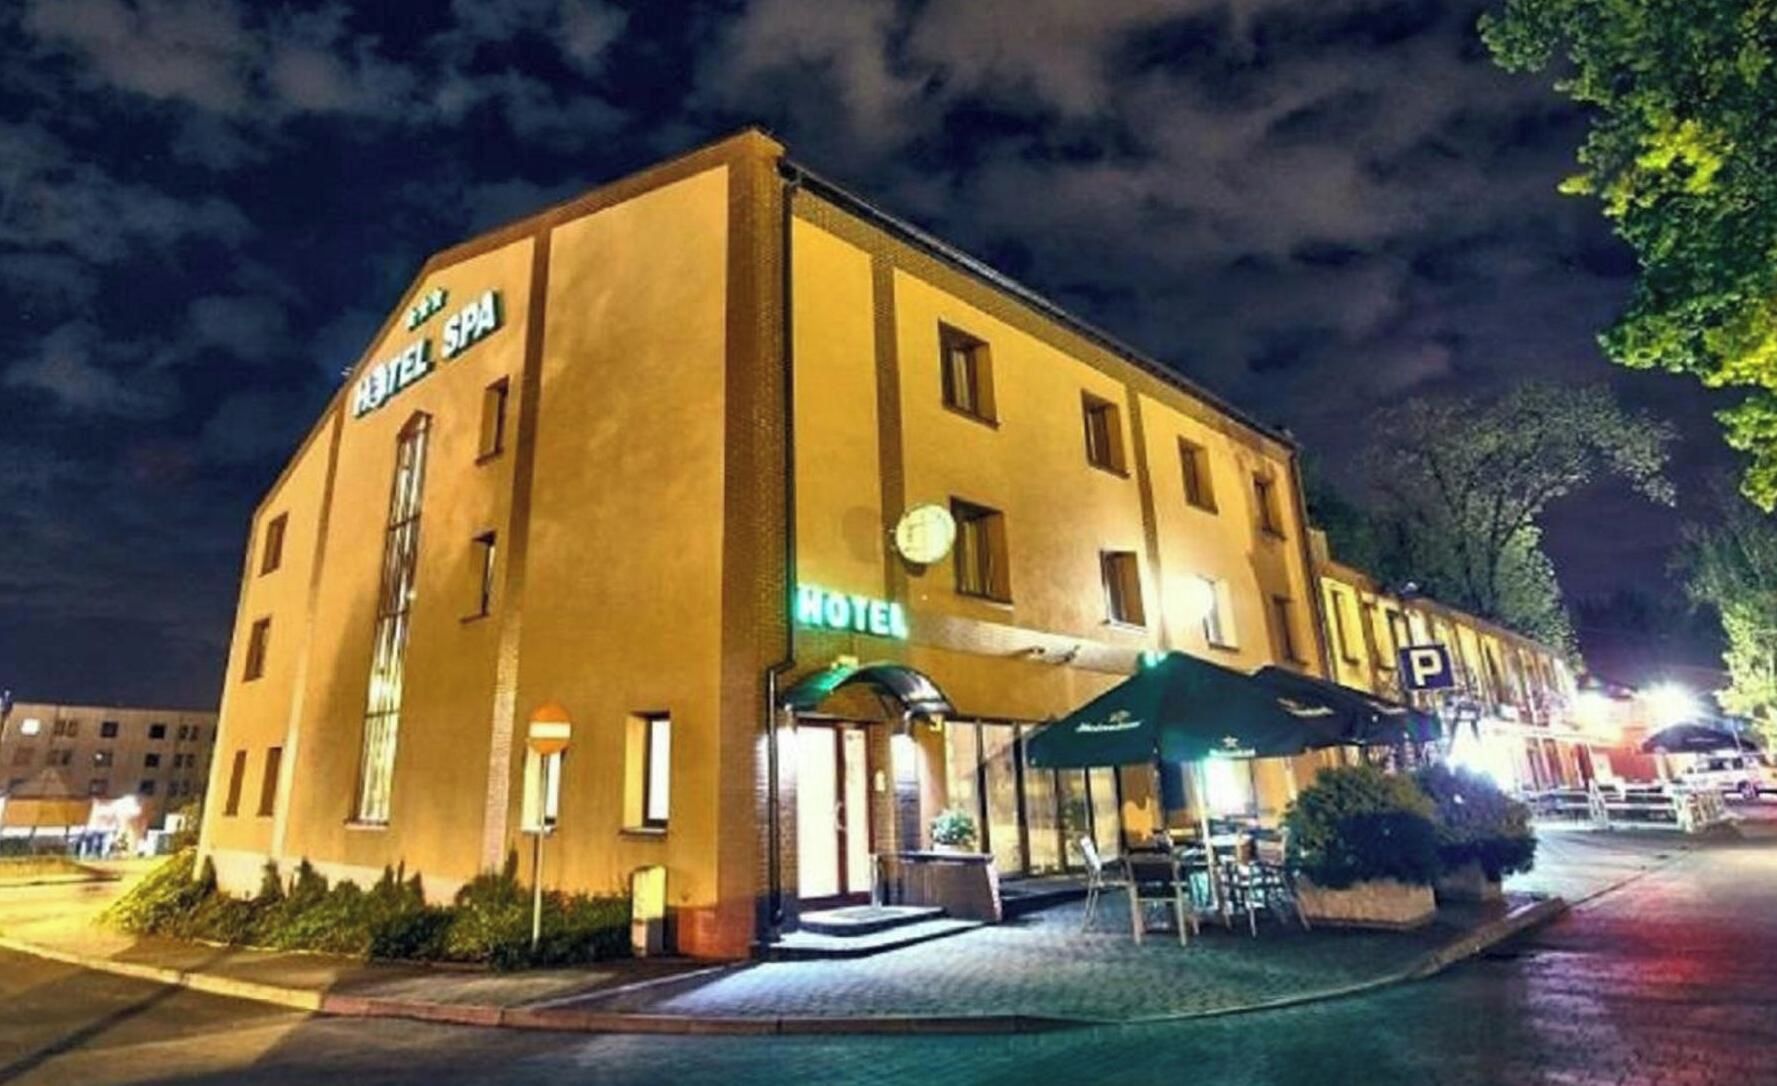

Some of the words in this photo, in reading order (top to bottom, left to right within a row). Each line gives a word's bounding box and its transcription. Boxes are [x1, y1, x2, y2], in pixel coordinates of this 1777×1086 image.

[352, 338, 433, 418] HOTEL
[441, 288, 502, 361] SPA
[796, 582, 909, 640] HOTEL
[1409, 649, 1443, 686] P
